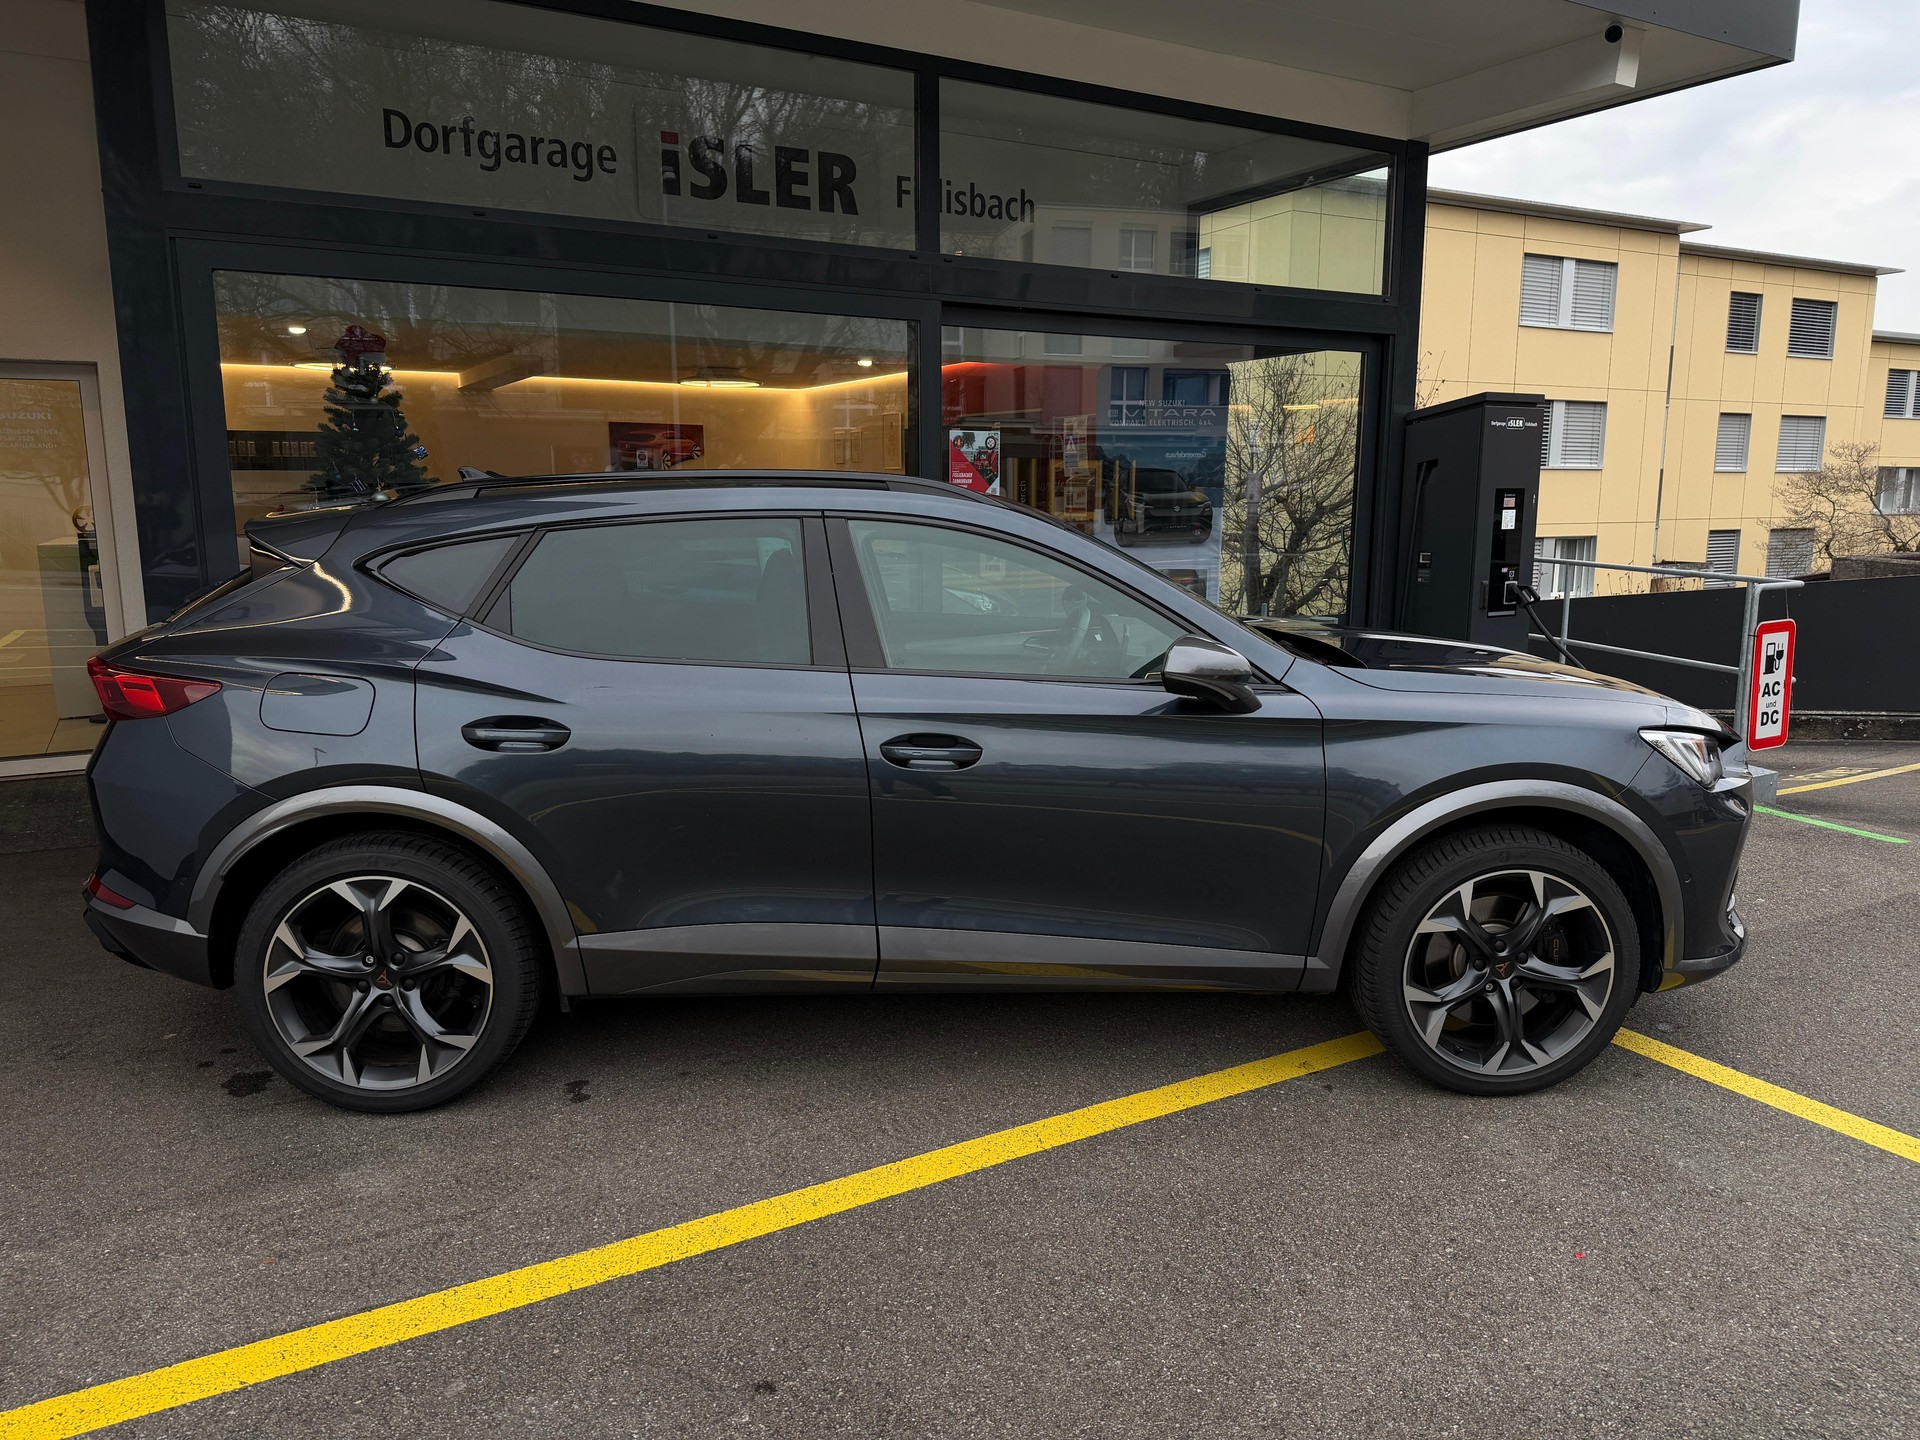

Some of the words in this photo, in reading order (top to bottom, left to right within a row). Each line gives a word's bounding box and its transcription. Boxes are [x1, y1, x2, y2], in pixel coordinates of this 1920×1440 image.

[383, 108, 617, 182] Dorfgarage
[1149, 419, 1196, 427] ELEKTRISCH.
[1762, 681, 1780, 697] AC
[1766, 700, 1776, 708] und
[1761, 710, 1779, 726] DC
